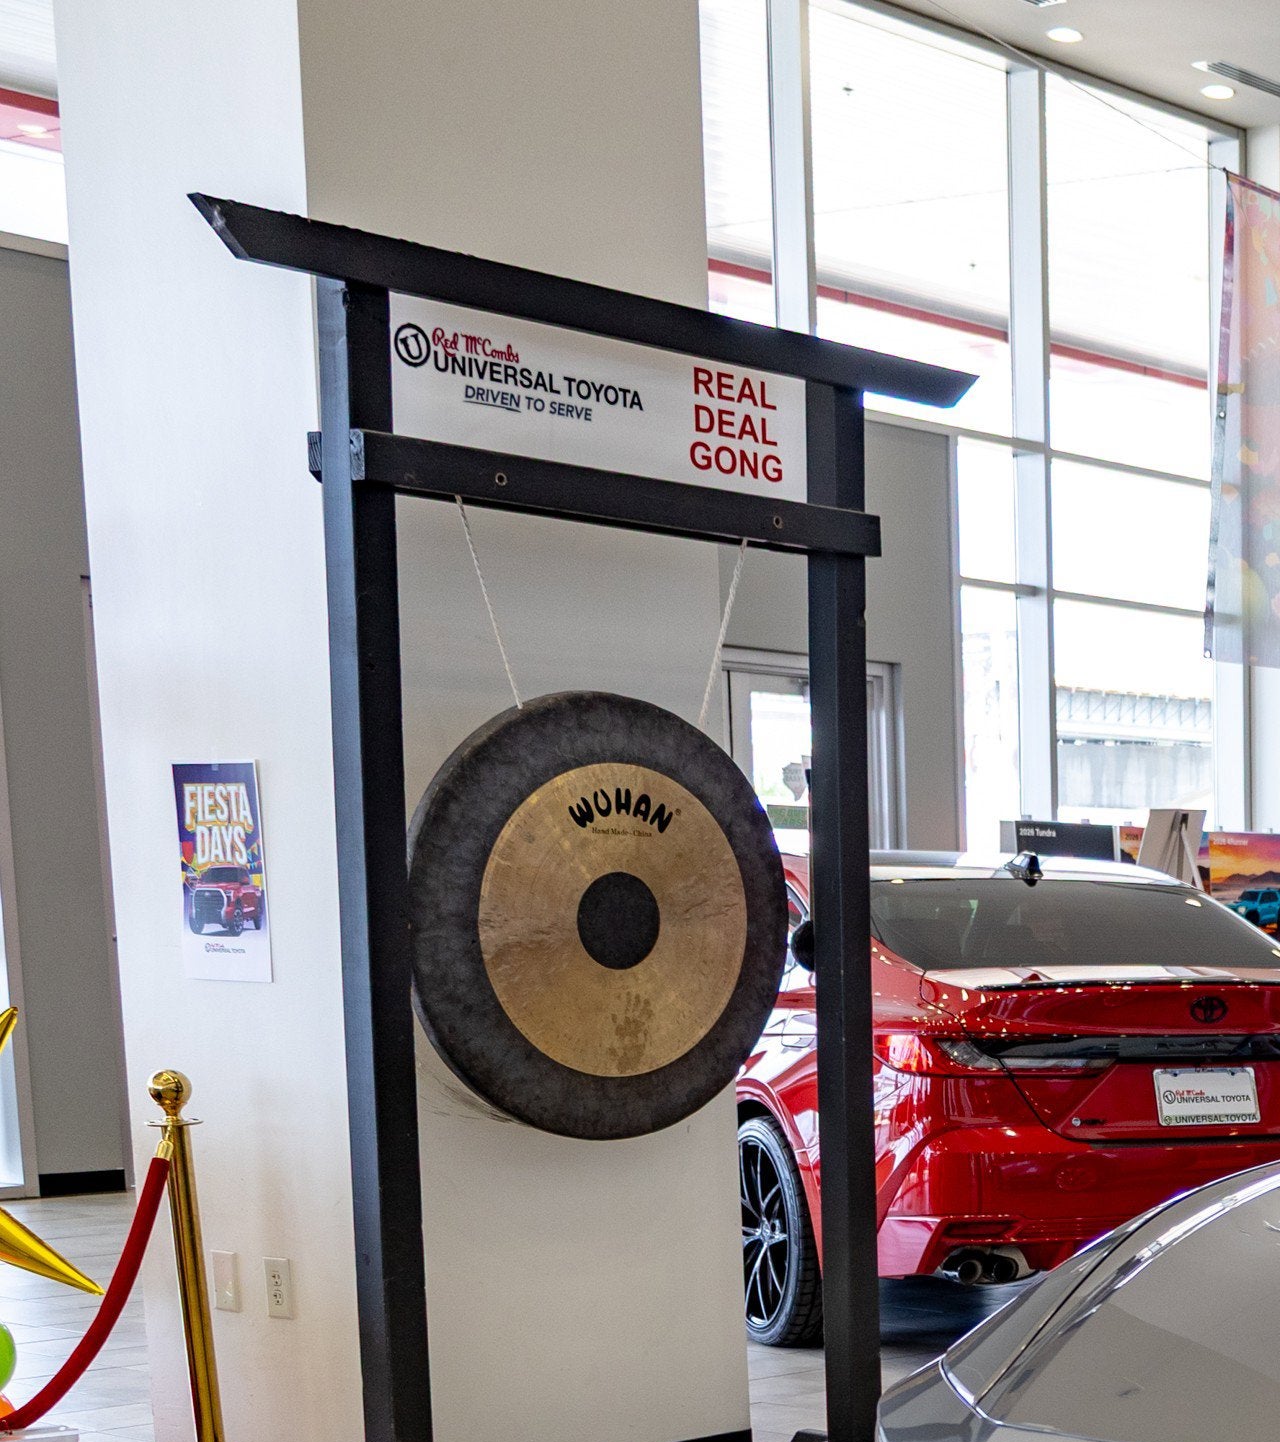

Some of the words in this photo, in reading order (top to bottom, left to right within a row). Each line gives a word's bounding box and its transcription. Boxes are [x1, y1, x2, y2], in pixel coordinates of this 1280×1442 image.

[432, 327, 458, 358] Red
[461, 333, 520, 364] McCombs
[434, 350, 561, 396] UNIVERSAL
[563, 376, 644, 412] TOYOTA
[693, 366, 777, 411] REAL
[465, 385, 521, 410] DRIVEN
[525, 396, 545, 413] TO
[550, 401, 593, 422] SERVE
[694, 404, 778, 447] DEAL
[690, 441, 784, 483] GONG
[183, 783, 254, 828] FIESTA
[568, 787, 674, 834] WUHAN
[195, 825, 249, 865] DAYS
[1035, 827, 1057, 838] Tundra
[1174, 1114, 1225, 1124] UNIVERSAL
[1225, 1113, 1257, 1122] TOYOTA
[1176, 1095, 1220, 1104] UNIVERSAL
[1221, 1094, 1251, 1102] TOYOTA
